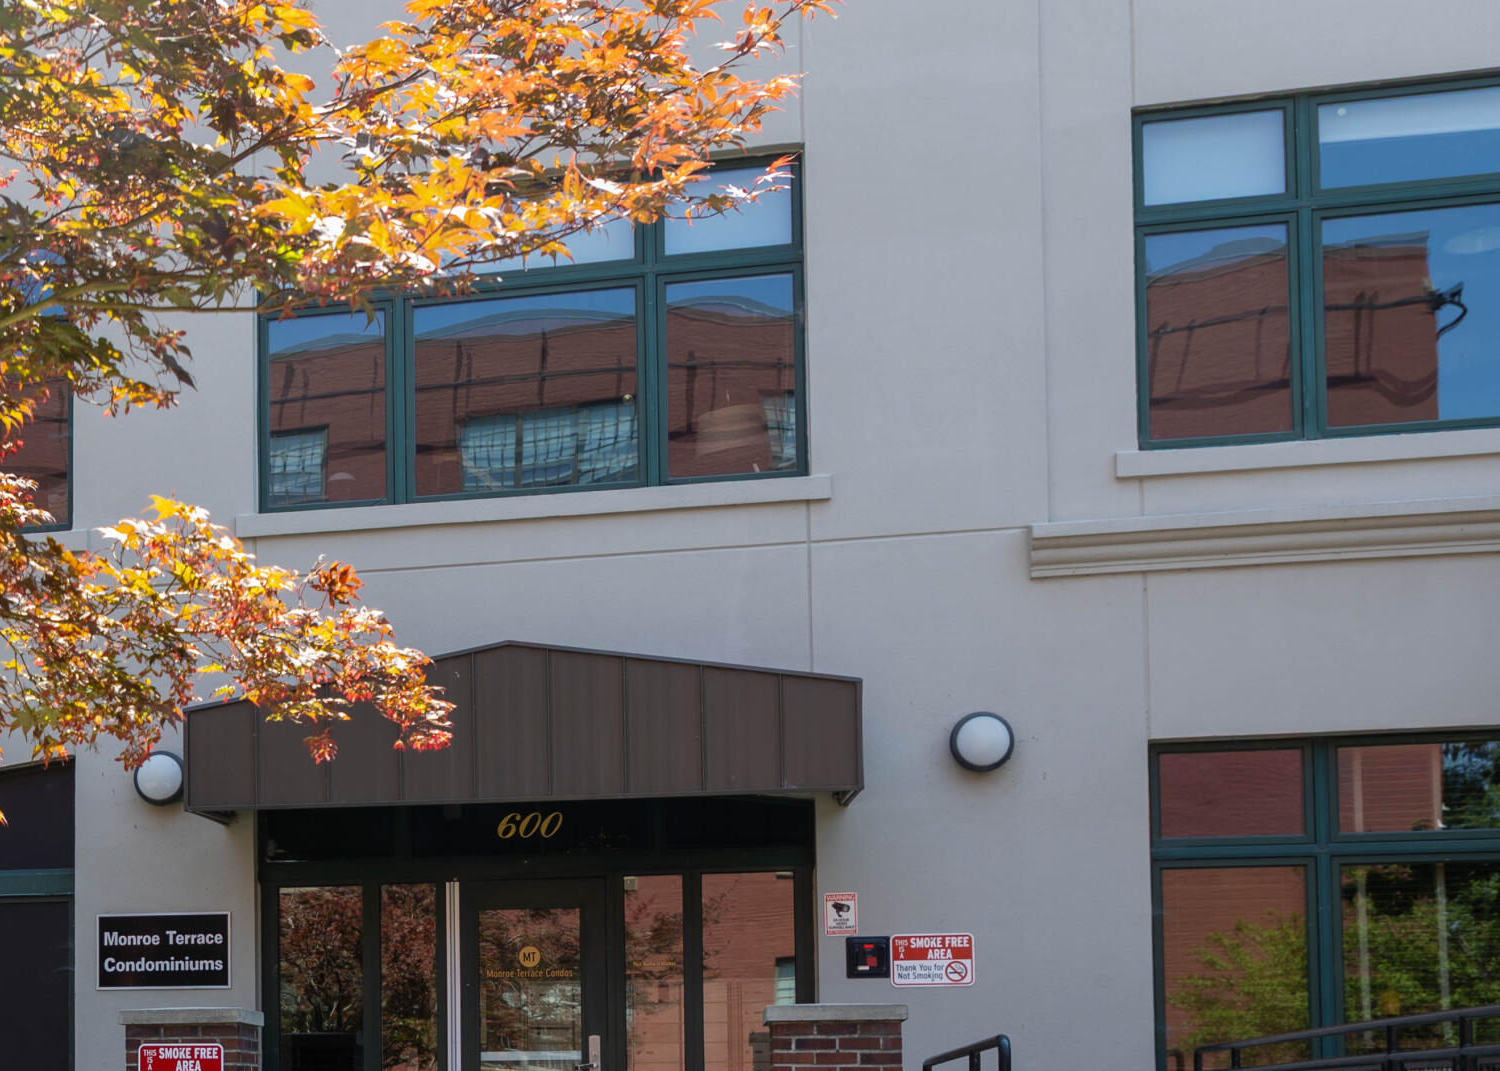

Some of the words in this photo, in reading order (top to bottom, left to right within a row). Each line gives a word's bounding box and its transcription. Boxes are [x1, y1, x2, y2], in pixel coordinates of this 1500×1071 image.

[497, 811, 563, 839] 600
[103, 931, 161, 946] Monroe
[165, 930, 224, 945] Terrace
[910, 937, 943, 948] SMOKE
[945, 936, 970, 947] FREE
[522, 952, 536, 962] MT
[927, 949, 953, 960] AREA
[103, 956, 224, 972] Condominiums
[896, 964, 918, 972] Thank
[919, 963, 932, 972] You
[934, 963, 944, 971] for
[486, 969, 514, 978] Monroe
[516, 968, 543, 978] Terrace
[545, 968, 573, 978] Condos
[898, 972, 911, 980] Not
[913, 972, 944, 981] Smoking
[143, 1049, 157, 1057] THIS
[158, 1047, 192, 1059] SMOKE
[194, 1047, 219, 1059] FREE
[175, 1060, 202, 1071] AREA
